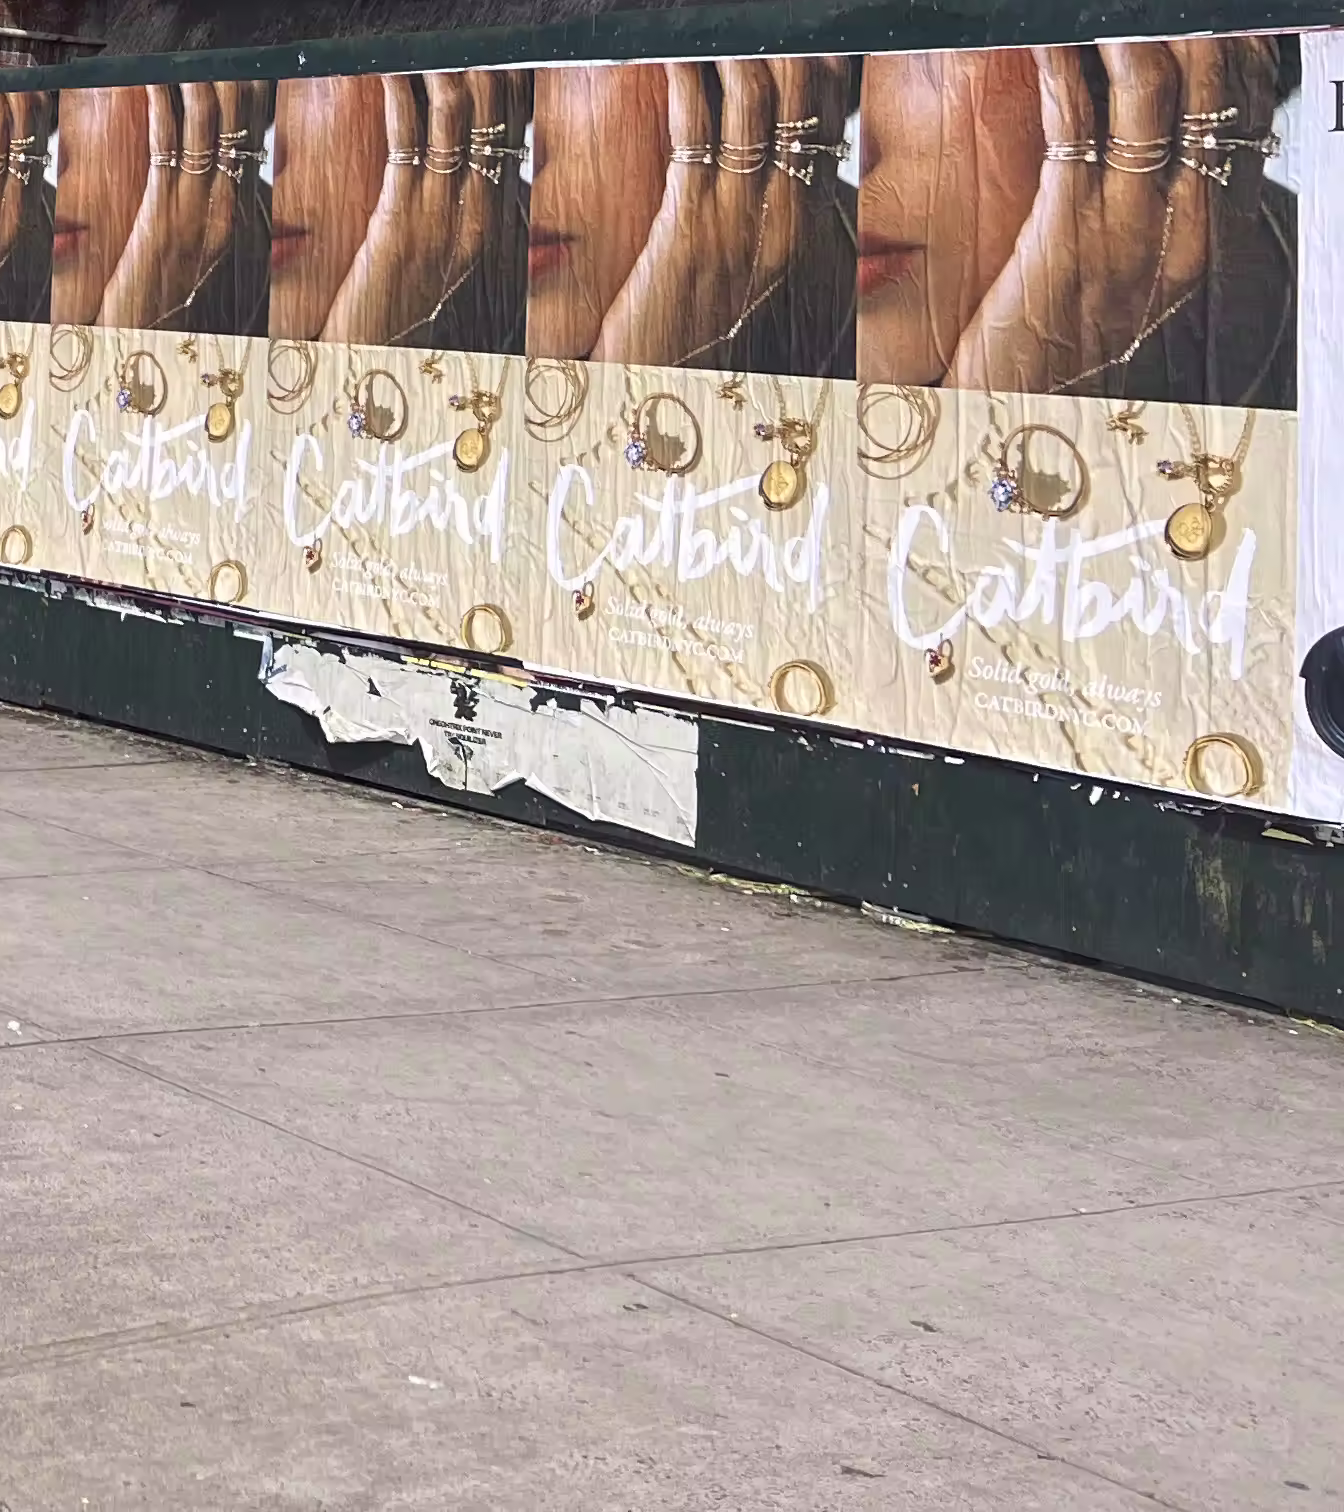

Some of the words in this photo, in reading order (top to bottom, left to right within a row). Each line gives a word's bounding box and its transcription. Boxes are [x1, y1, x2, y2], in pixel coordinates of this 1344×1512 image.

[63, 409, 252, 523] Catbird
[283, 433, 509, 564] Catbird
[547, 463, 830, 614] Catbird
[887, 505, 1257, 681] Catbird
[605, 596, 647, 622] Solid
[693, 610, 754, 642] always
[481, 727, 503, 739] NEVER
[968, 655, 1022, 684] Solid
[1023, 666, 1077, 696] gold,
[1082, 674, 1163, 713] always
